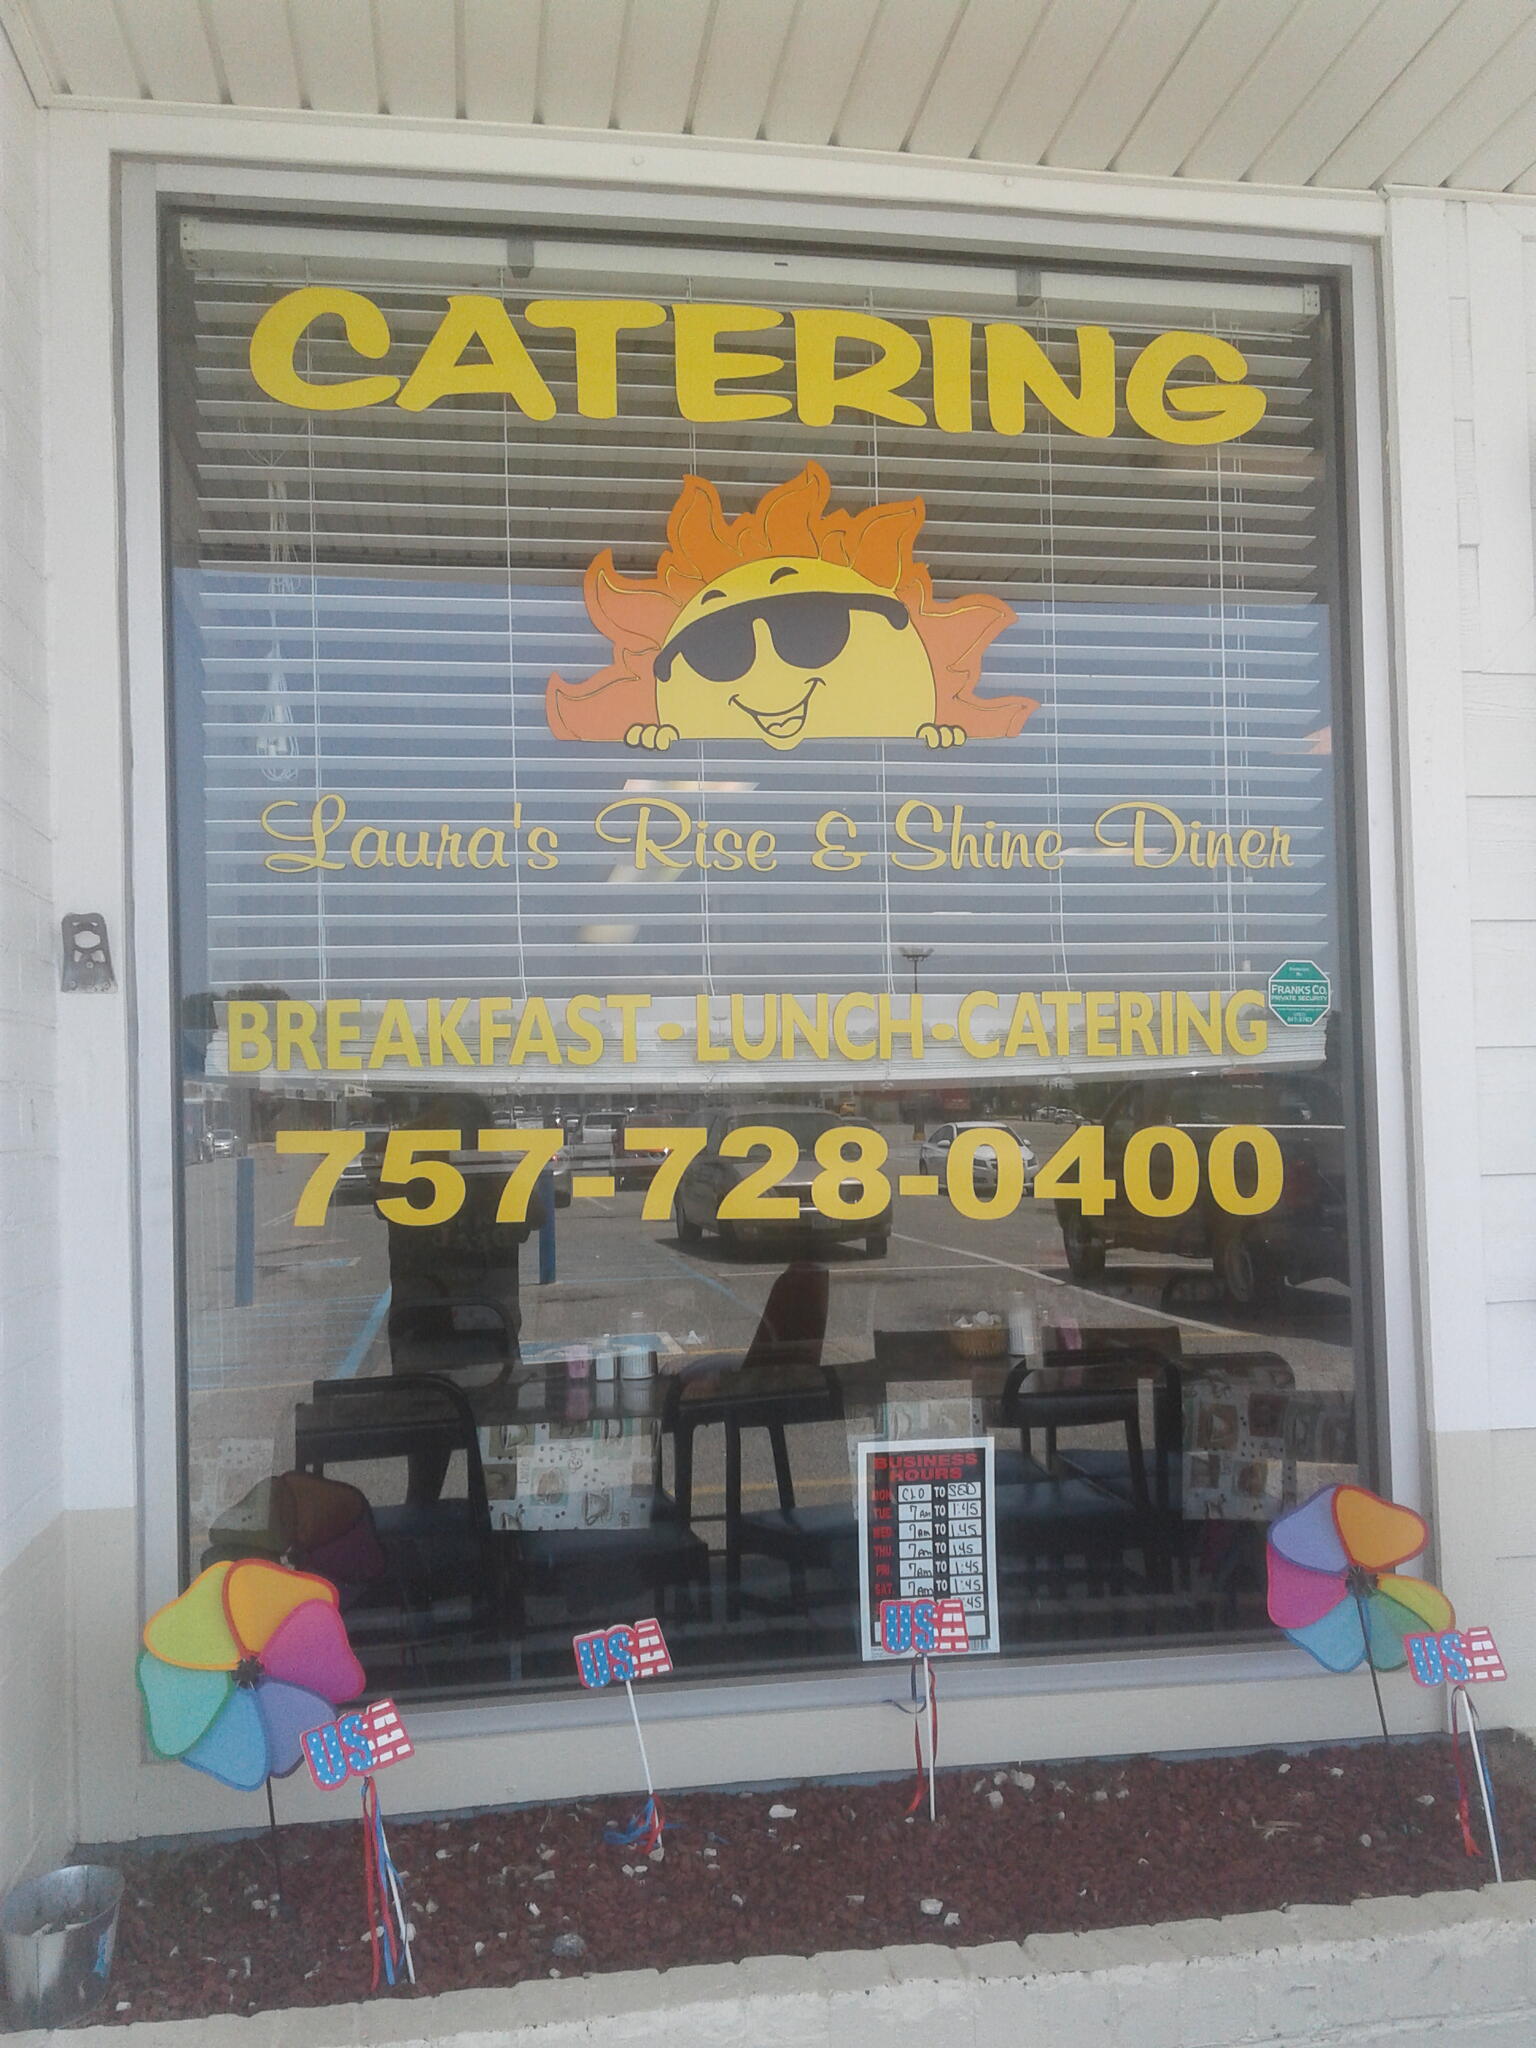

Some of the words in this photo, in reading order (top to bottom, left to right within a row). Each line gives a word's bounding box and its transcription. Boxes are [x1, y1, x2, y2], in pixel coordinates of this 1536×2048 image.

[249, 286, 1267, 446] CATERING
[261, 794, 558, 873] Laura's
[594, 797, 778, 872] Rise
[811, 809, 869, 872] &
[890, 799, 1064, 871] Shine
[1094, 801, 1295, 869] Diner
[1271, 984, 1311, 995] FRANKS
[227, 993, 652, 1072] BREAKFAST
[696, 991, 924, 1062] LUNCH
[958, 989, 1269, 1059] CATERING
[275, 1124, 1284, 1227] 757-728-0400
[873, 1453, 978, 1469] BUSINESS
[889, 1467, 963, 1482] HOURS
[934, 1486, 946, 1498] TO
[934, 1505, 946, 1517] TO
[934, 1523, 947, 1535] TO
[935, 1542, 947, 1554] TO
[935, 1561, 948, 1573] TO
[955, 1560, 980, 1575] 1:45
[936, 1580, 948, 1592] TO
[954, 1578, 981, 1593] 1:45
[880, 1598, 970, 1655] USA
[573, 1617, 674, 1689] USA
[1403, 1626, 1508, 1688] USA
[300, 1698, 416, 1791] USA
